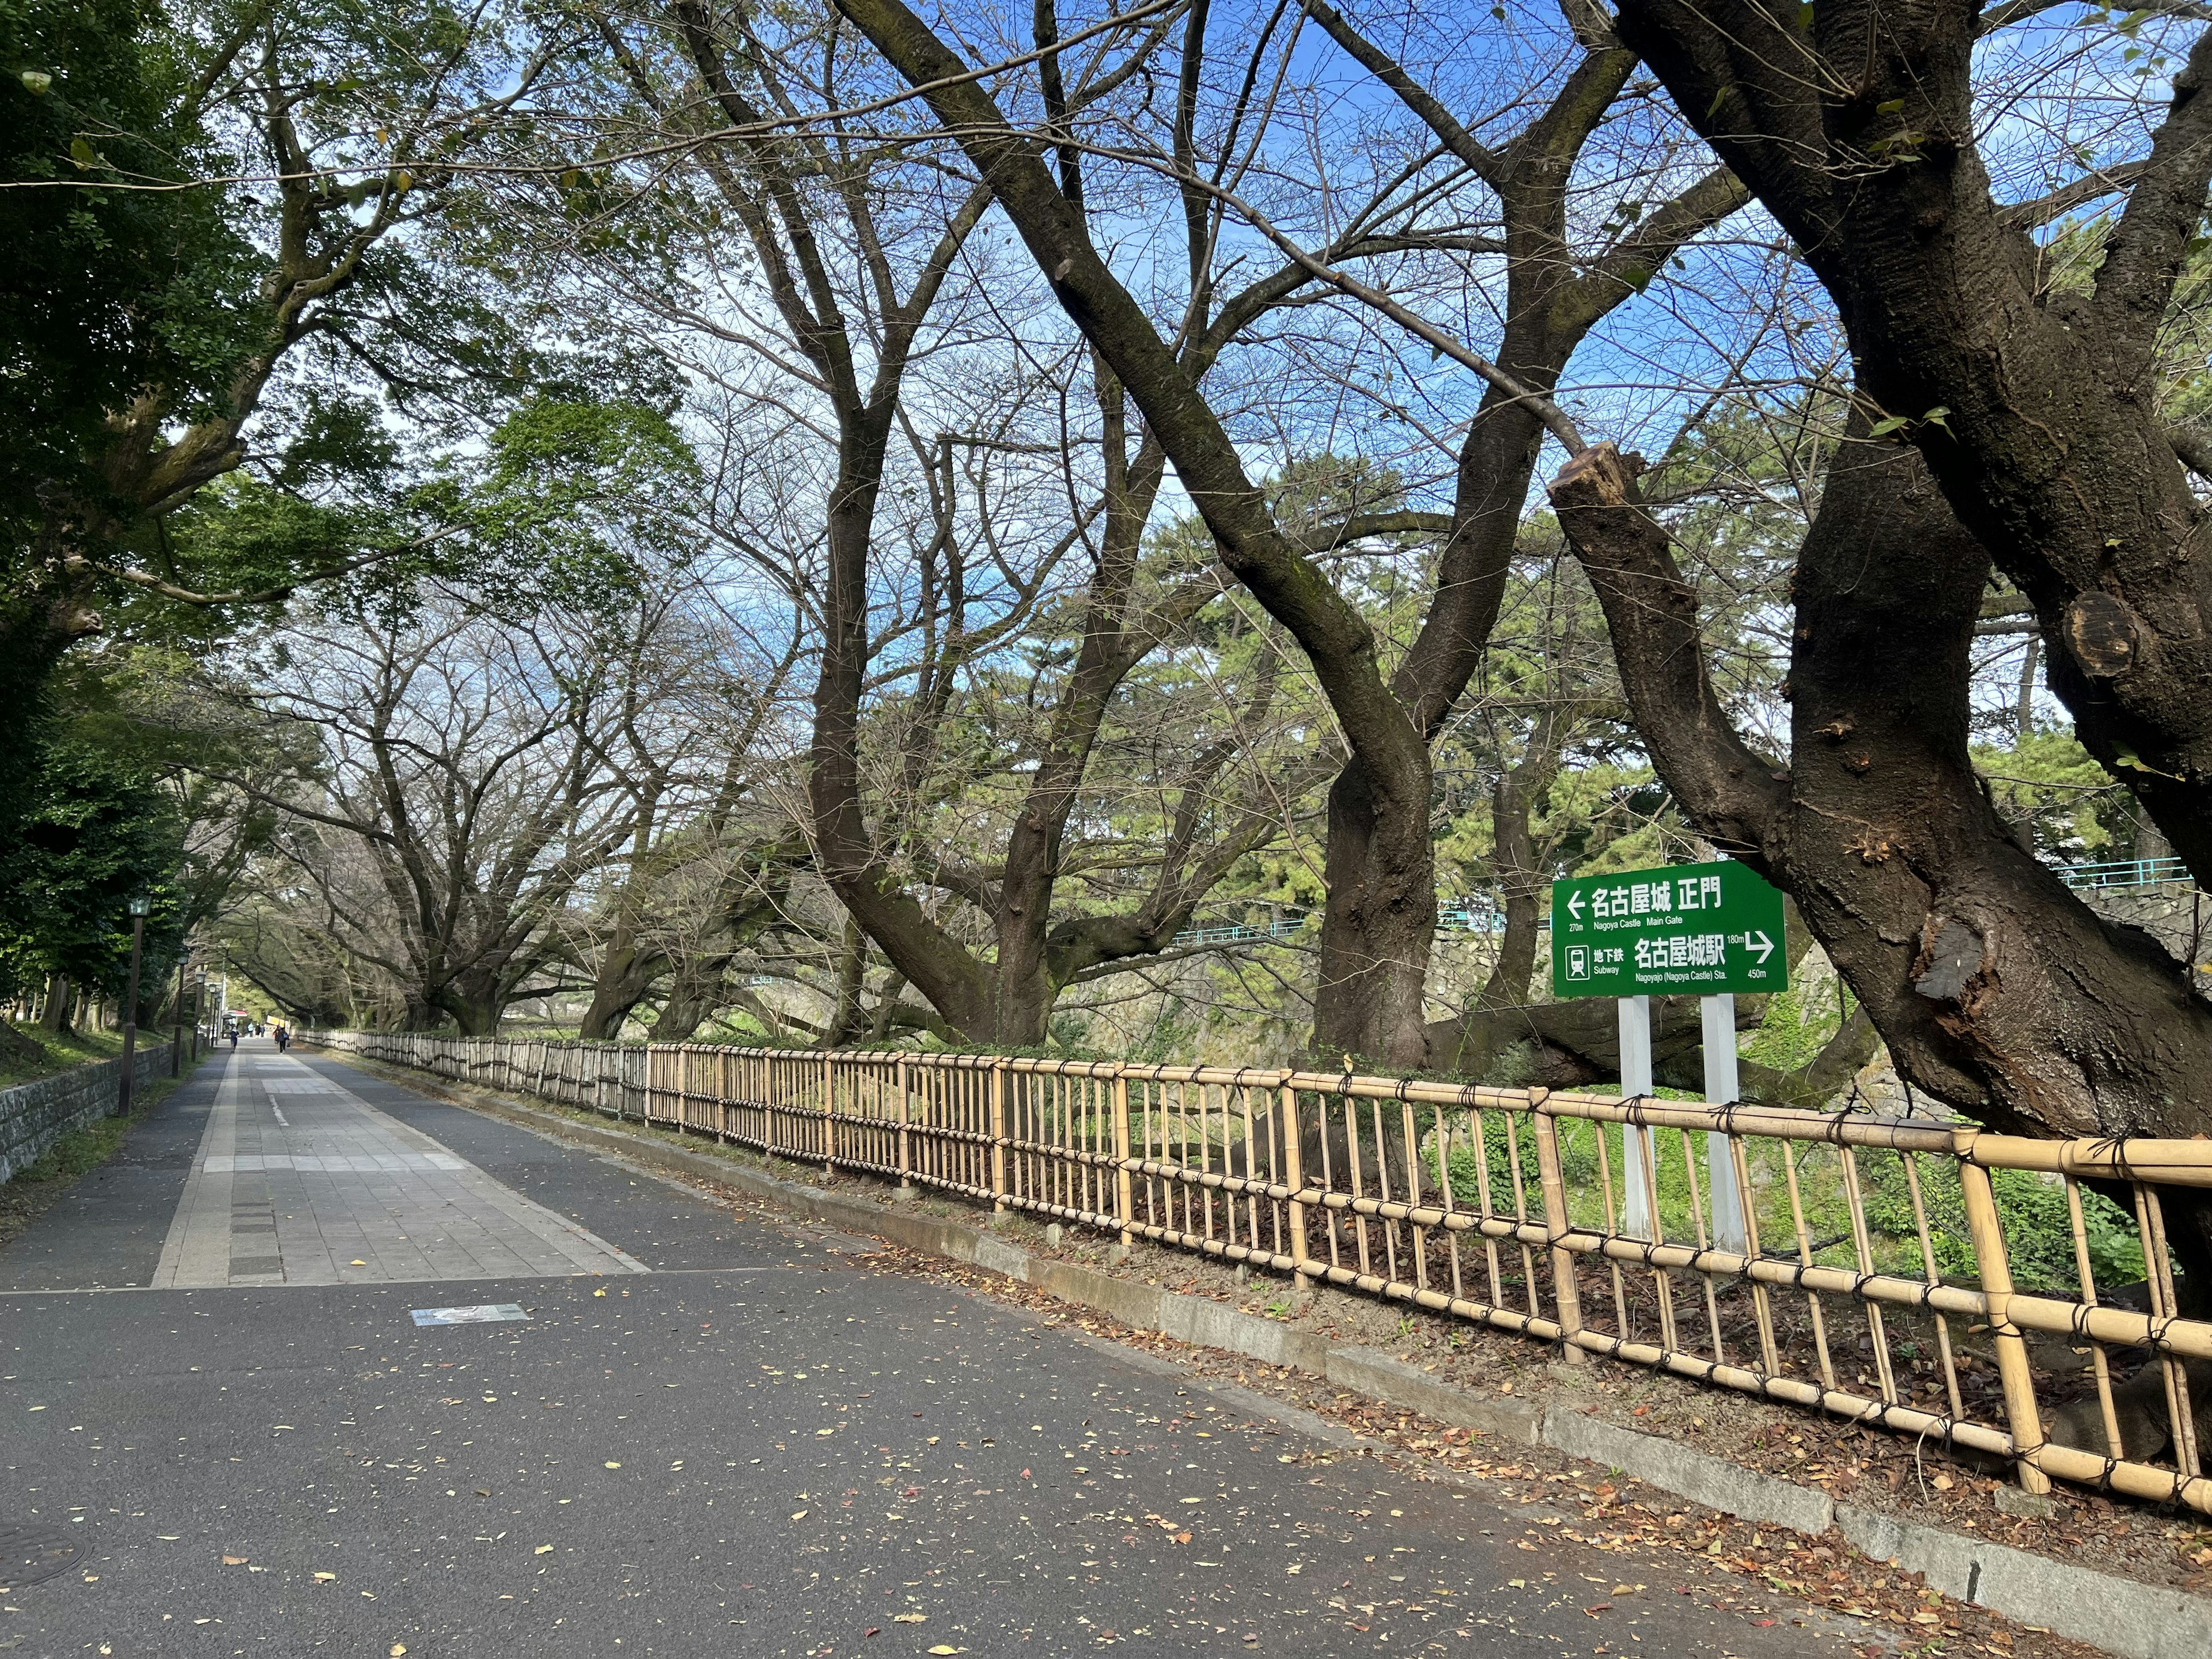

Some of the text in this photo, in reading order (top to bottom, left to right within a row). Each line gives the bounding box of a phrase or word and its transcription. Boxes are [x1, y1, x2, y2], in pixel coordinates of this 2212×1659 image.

[1592, 876, 1721, 918] 名古屋城 正門
[1569, 923, 1584, 932] 270m
[1593, 915, 1683, 931] Nagoya Castle Main Gate
[1727, 934, 1745, 944] 180m
[1593, 948, 1624, 963] 地下鉄
[1634, 934, 1726, 969] 名古屋城駅
[1593, 965, 1619, 975] Subway
[1635, 969, 1728, 984] Nagoyajo (Nagoya Castle) Sta.
[1747, 969, 1767, 979] 450m
